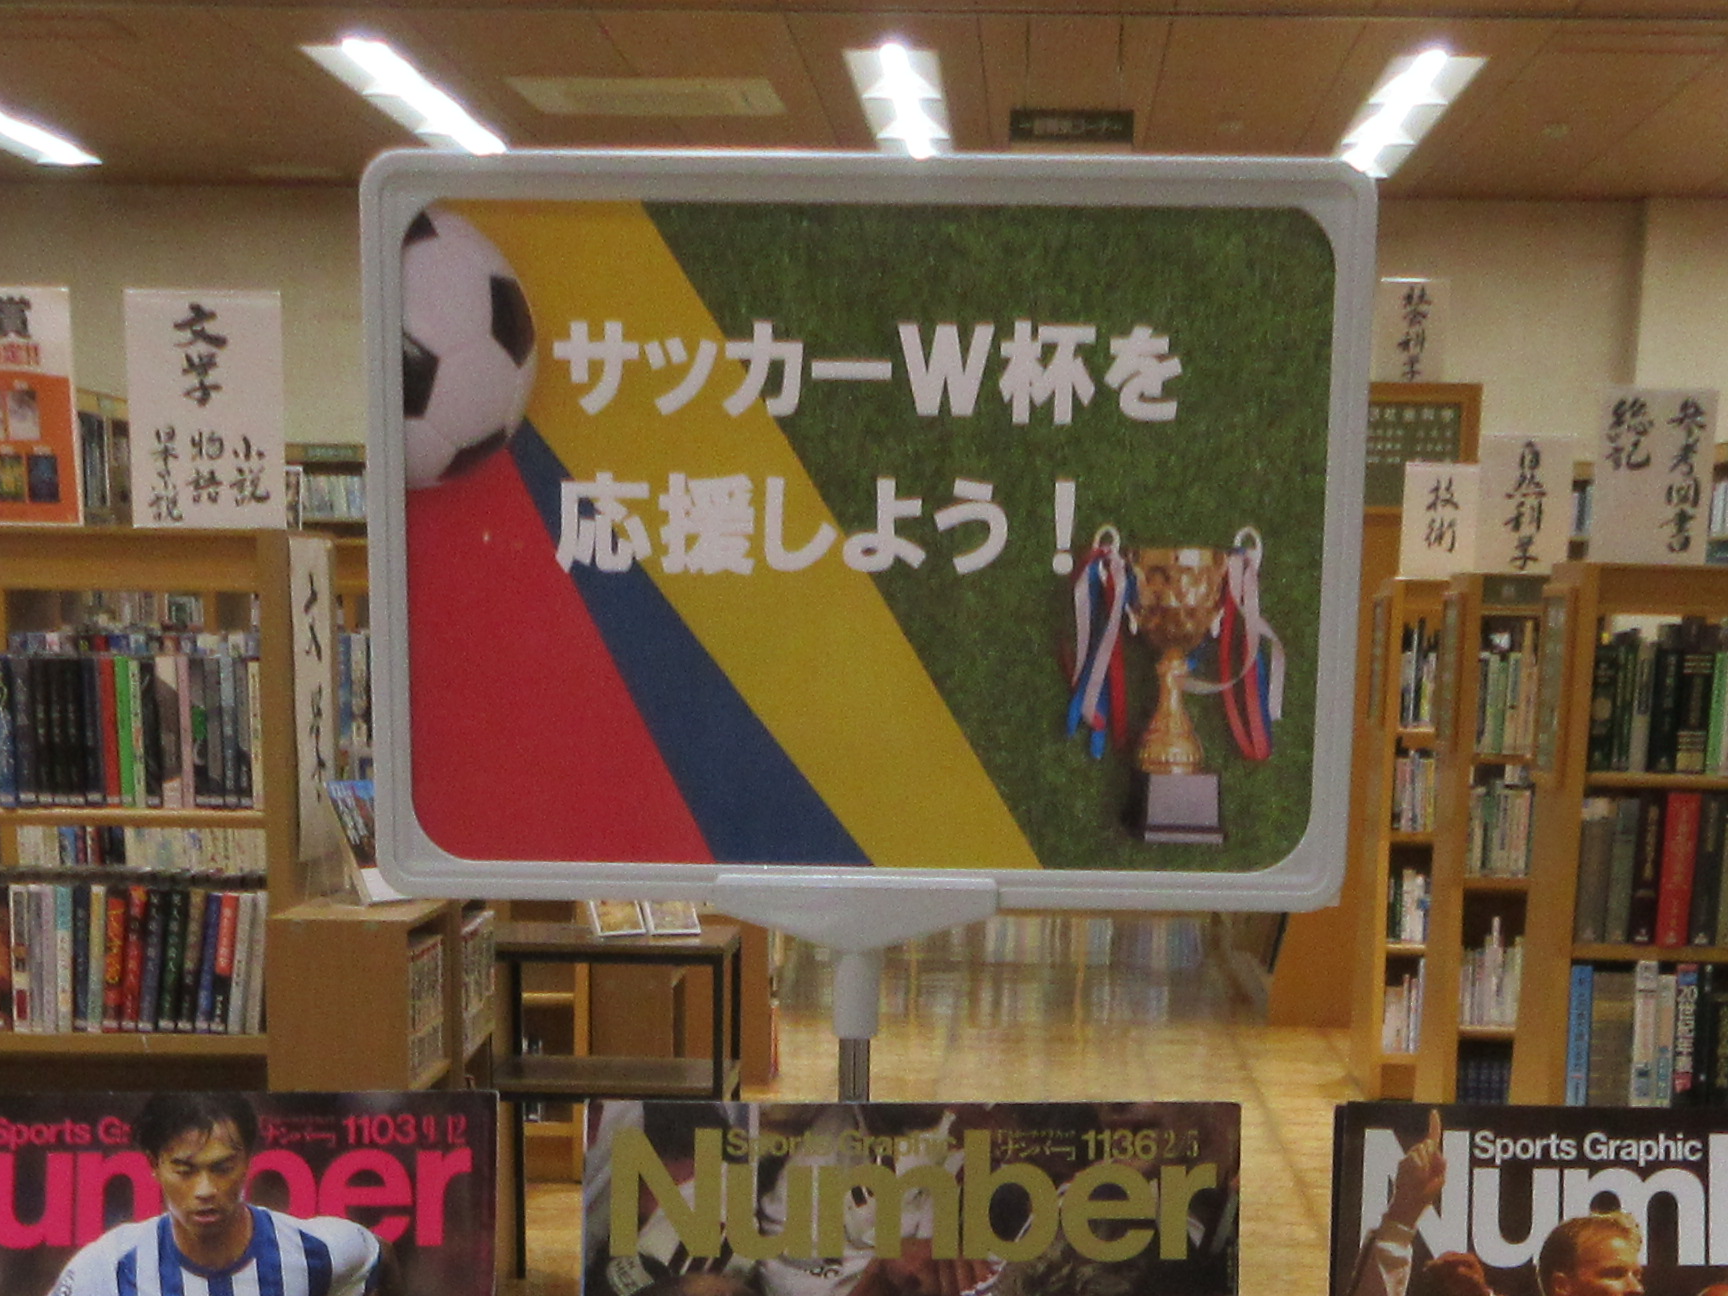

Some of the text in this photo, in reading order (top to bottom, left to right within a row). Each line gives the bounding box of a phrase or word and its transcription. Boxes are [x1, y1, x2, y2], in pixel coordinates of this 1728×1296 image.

[174, 304, 227, 406] 文学
[552, 319, 1183, 425] サッカーW杯を
[190, 434, 223, 504] 物語
[232, 436, 270, 505] 小説
[554, 474, 1075, 575] 応援しよう！
[1425, 477, 1459, 553] 技術
[342, 1114, 418, 1145] 1103
[1080, 1130, 1159, 1160] 1136
[1473, 1131, 1702, 1165] Sports Graphic
[609, 1127, 1217, 1262] Number
